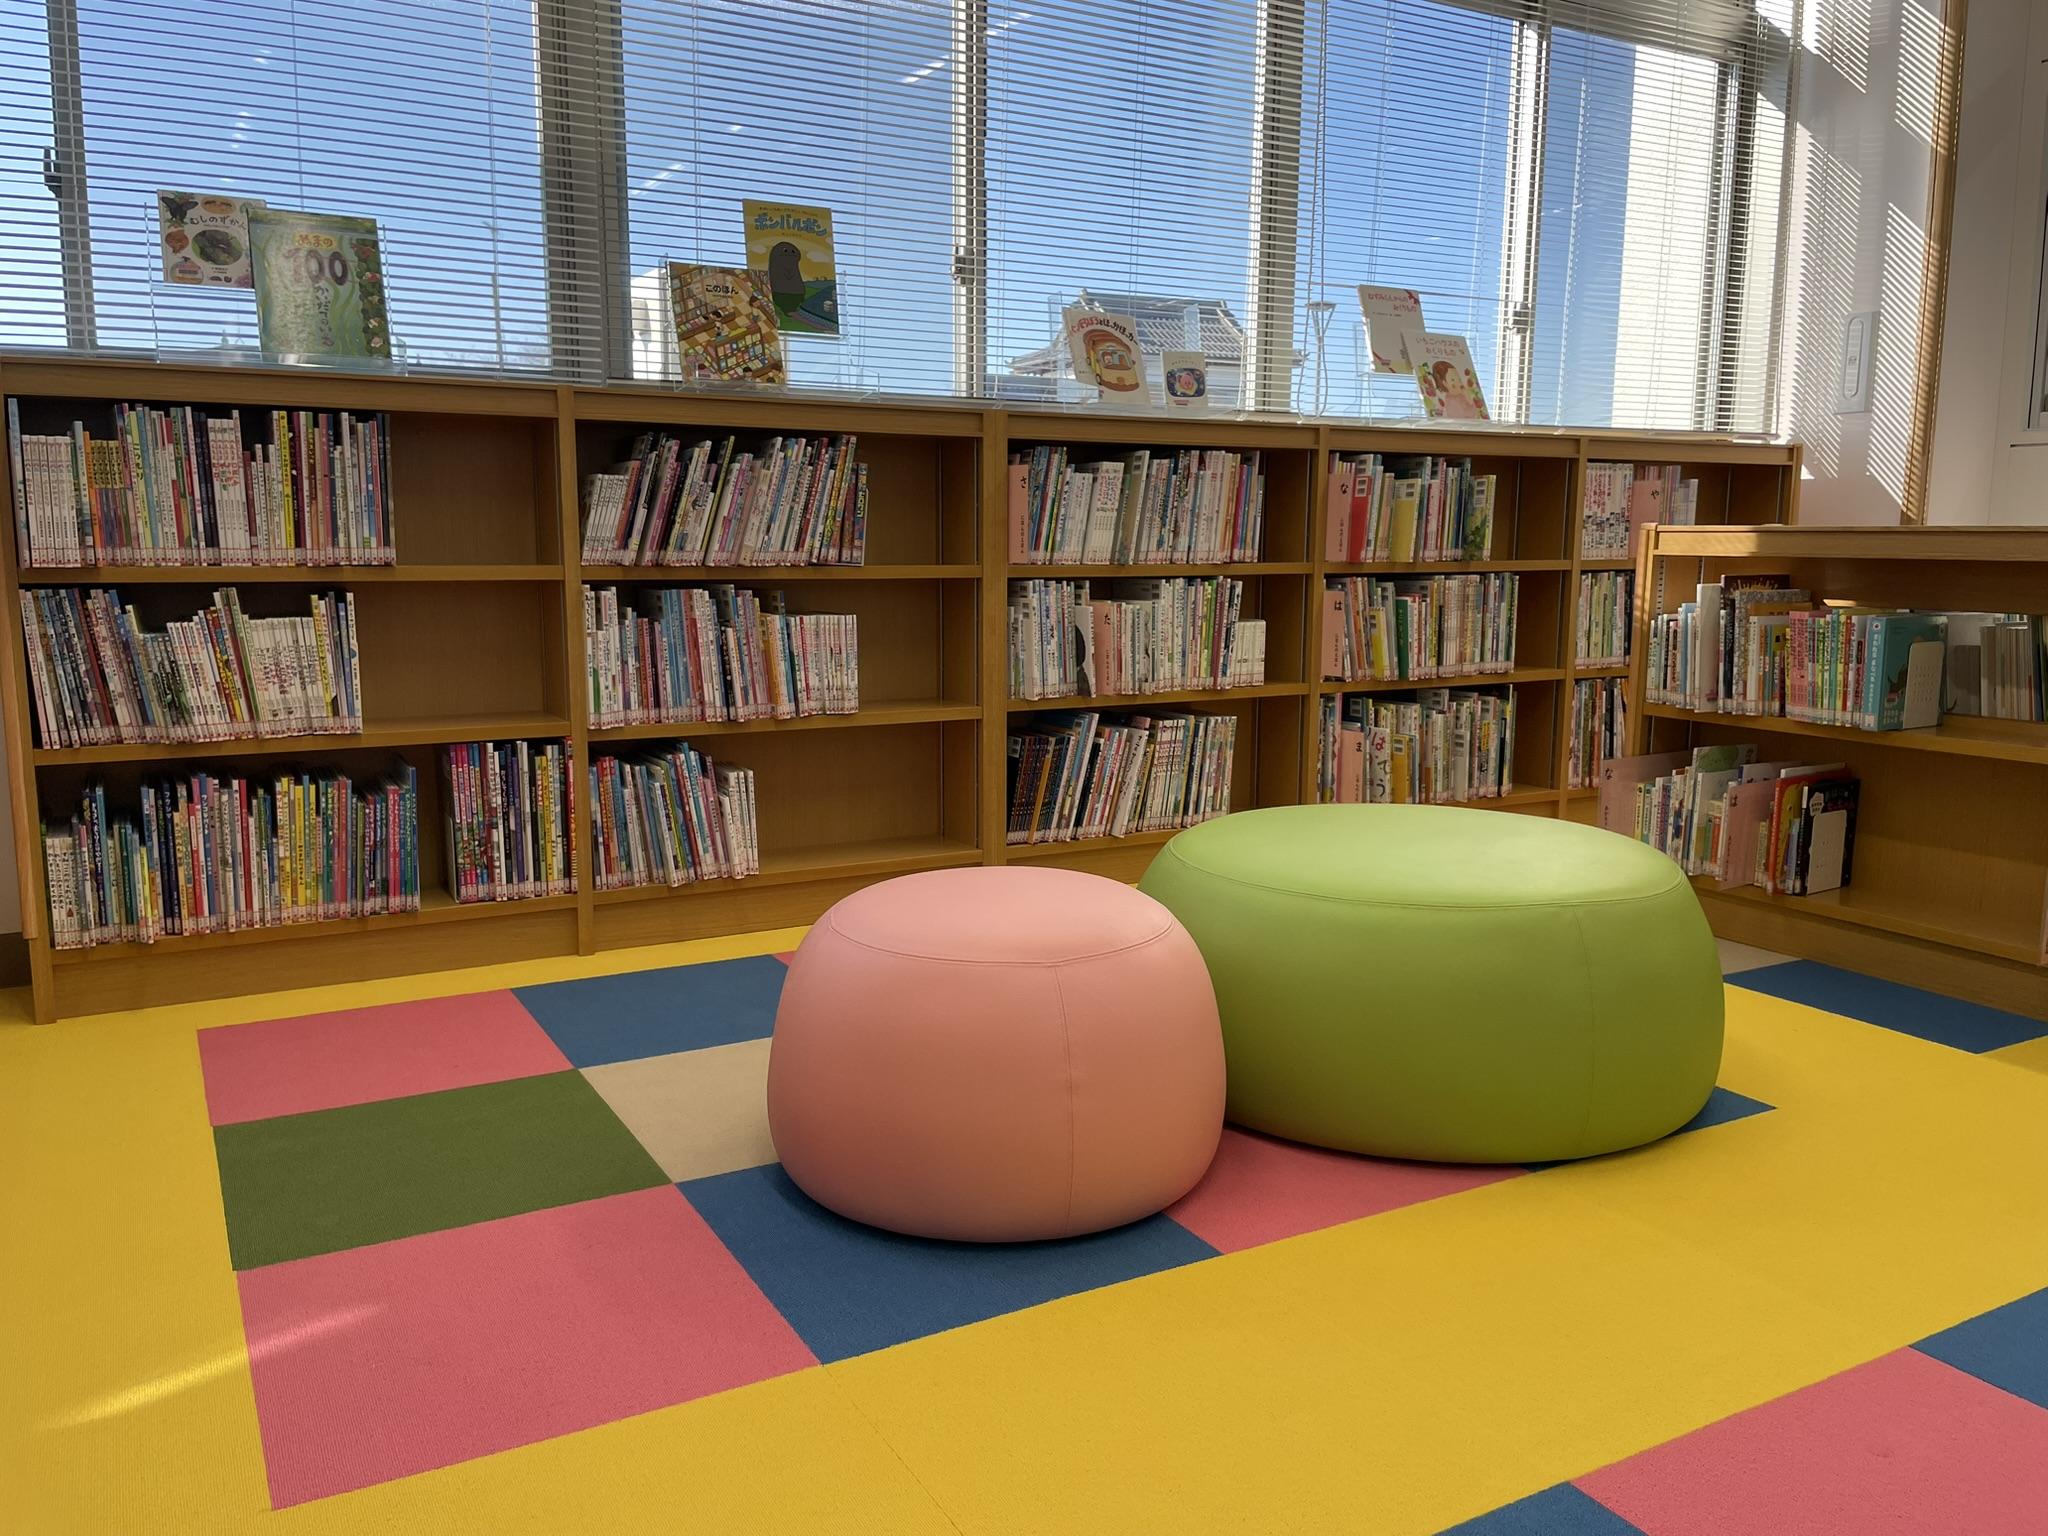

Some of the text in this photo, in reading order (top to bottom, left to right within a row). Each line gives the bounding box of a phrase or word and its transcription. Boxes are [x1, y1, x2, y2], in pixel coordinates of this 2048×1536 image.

[705, 284, 740, 295] このほん
[1020, 476, 1027, 489] さ
[1650, 489, 1660, 500] や
[1334, 600, 1342, 611] は
[1103, 613, 1111, 626] た
[1355, 741, 1363, 753] ま
[1604, 767, 1614, 781] な
